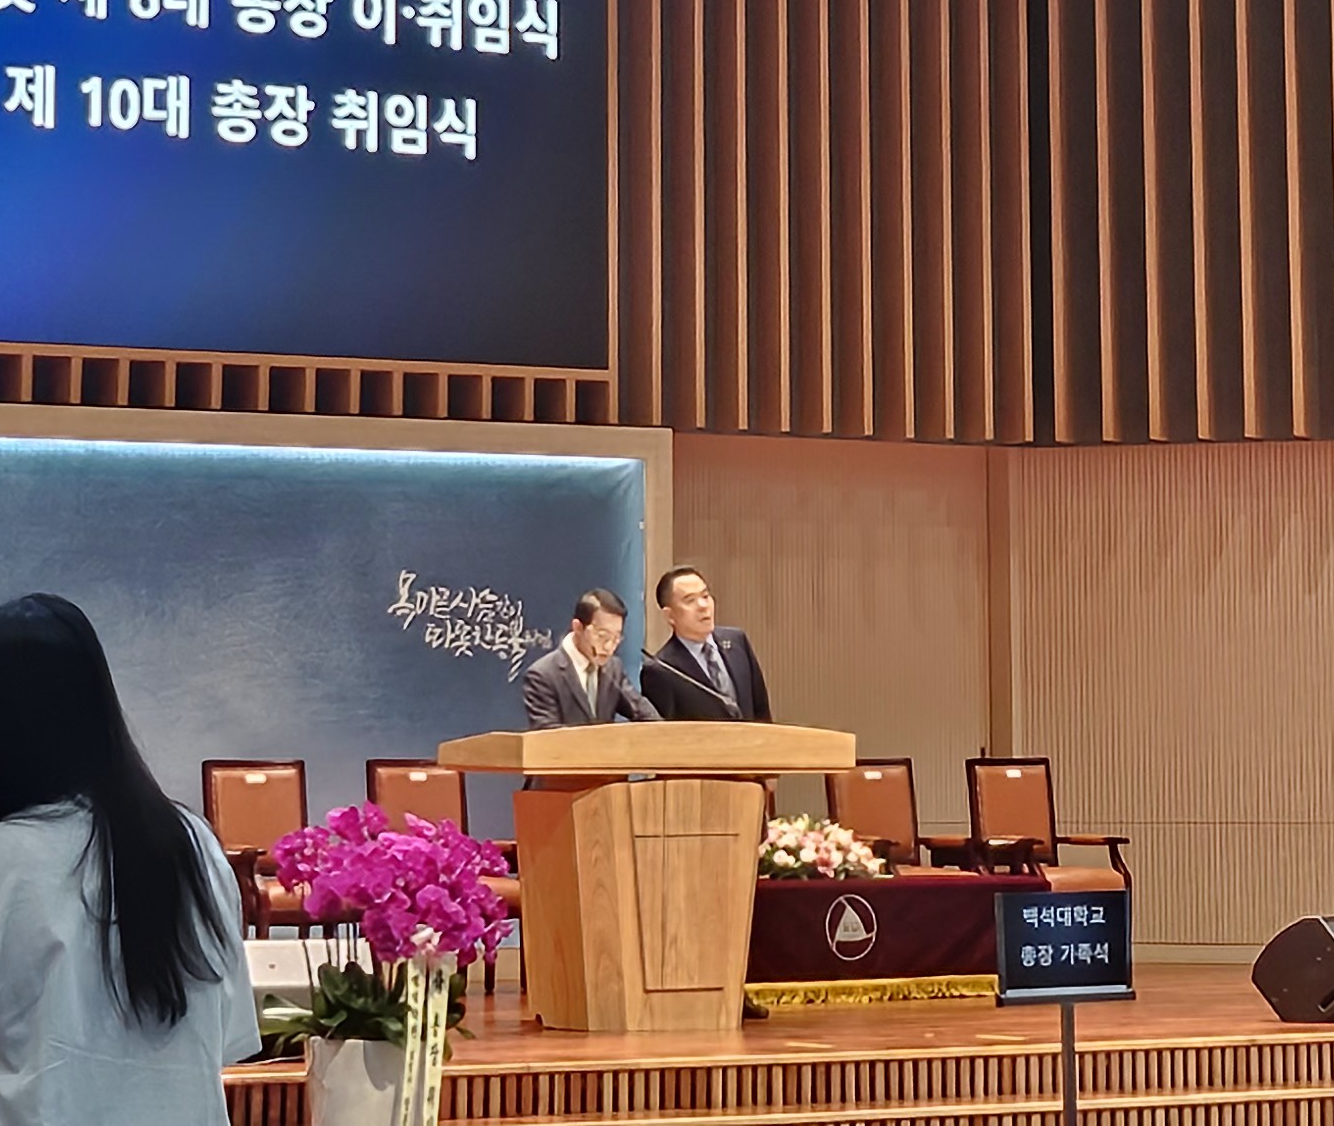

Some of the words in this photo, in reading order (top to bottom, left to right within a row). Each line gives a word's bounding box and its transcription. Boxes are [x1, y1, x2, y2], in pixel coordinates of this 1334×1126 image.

[4, 65, 55, 128] 제
[81, 76, 189, 138] 10대
[211, 80, 315, 146] 총장
[332, 89, 476, 159] 취임식
[1022, 905, 1106, 928] 백석대학교
[1021, 944, 1054, 967] 총장
[1060, 942, 1110, 966] 가족석
